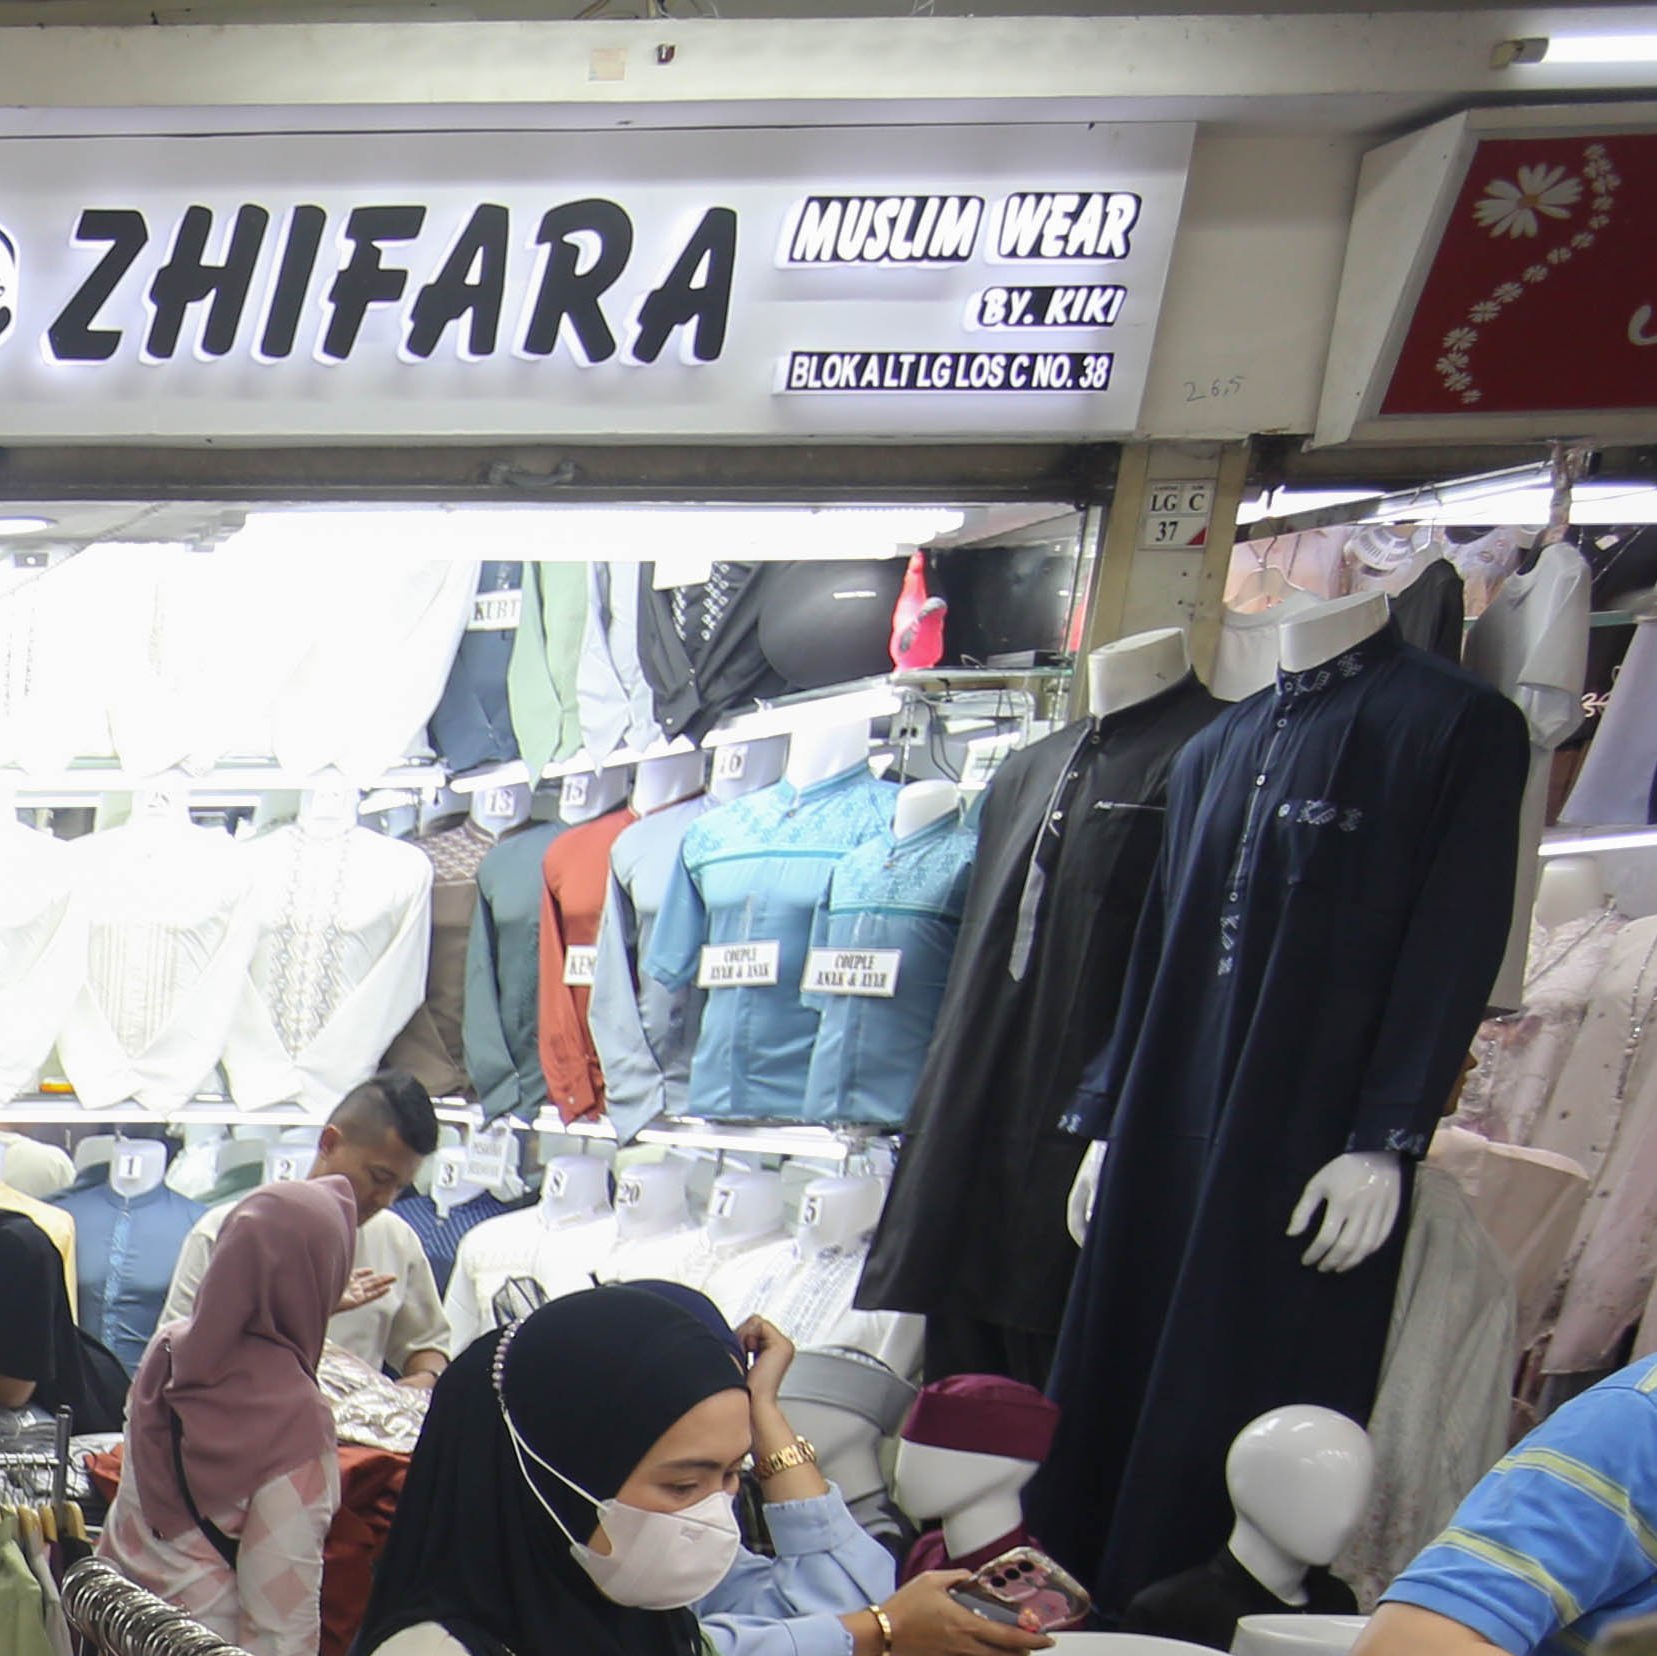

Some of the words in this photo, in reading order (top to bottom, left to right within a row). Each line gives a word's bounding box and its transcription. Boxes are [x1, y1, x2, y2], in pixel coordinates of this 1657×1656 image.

[791, 197, 981, 261] MUSLIM
[998, 194, 1137, 258] WEAR
[48, 197, 739, 363] ZHIFARA
[981, 287, 1035, 325] BY.
[1045, 287, 1126, 325] KIKI
[791, 355, 858, 388] BLOK
[859, 355, 881, 387] A
[882, 355, 914, 387] LT
[916, 355, 951, 387] LG
[955, 355, 1005, 387] LOS
[1009, 355, 1029, 387] C
[1031, 355, 1074, 387] NO.
[1079, 355, 1109, 388] 38
[1151, 494, 1178, 512] LG
[1189, 493, 1205, 511] C
[1155, 520, 1179, 542] 37
[834, 954, 875, 971] COUPLE
[126, 1156, 136, 1176] 1
[278, 1159, 294, 1180] 2
[443, 1166, 454, 1186] 3
[619, 1183, 641, 1204] 20
[719, 1191, 731, 1215] 7
[803, 1199, 817, 1222] 5
